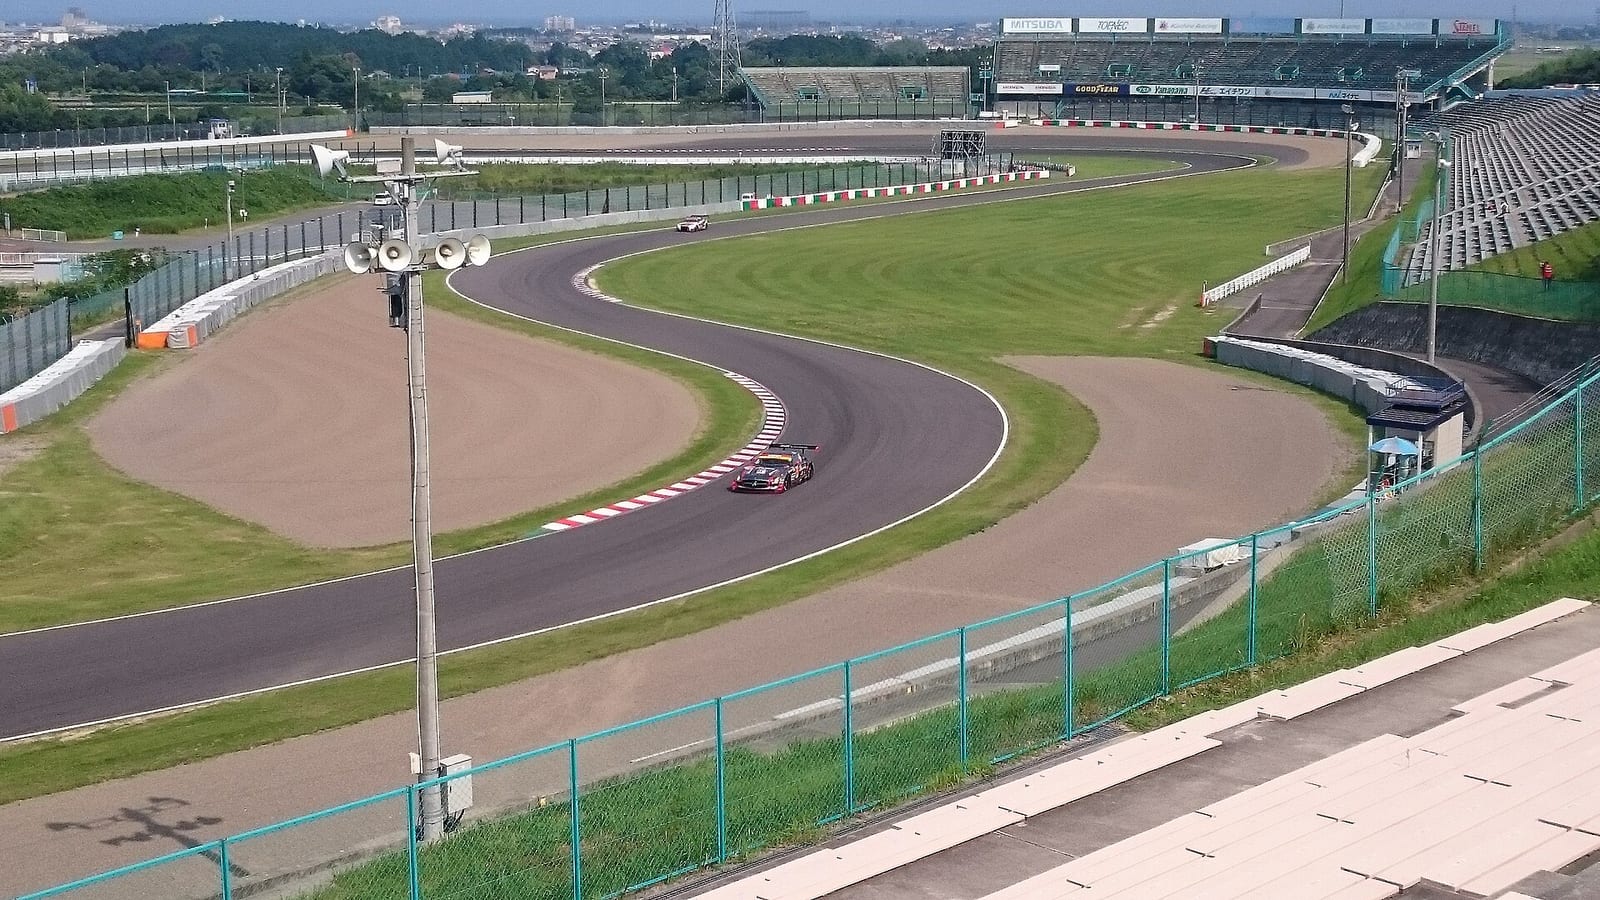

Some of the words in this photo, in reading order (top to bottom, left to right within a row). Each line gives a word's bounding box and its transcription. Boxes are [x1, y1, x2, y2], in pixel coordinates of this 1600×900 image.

[1010, 20, 1064, 29] MITSUBA
[1075, 84, 1119, 94] GOODYEAR
[1219, 87, 1251, 95] エイチワン
